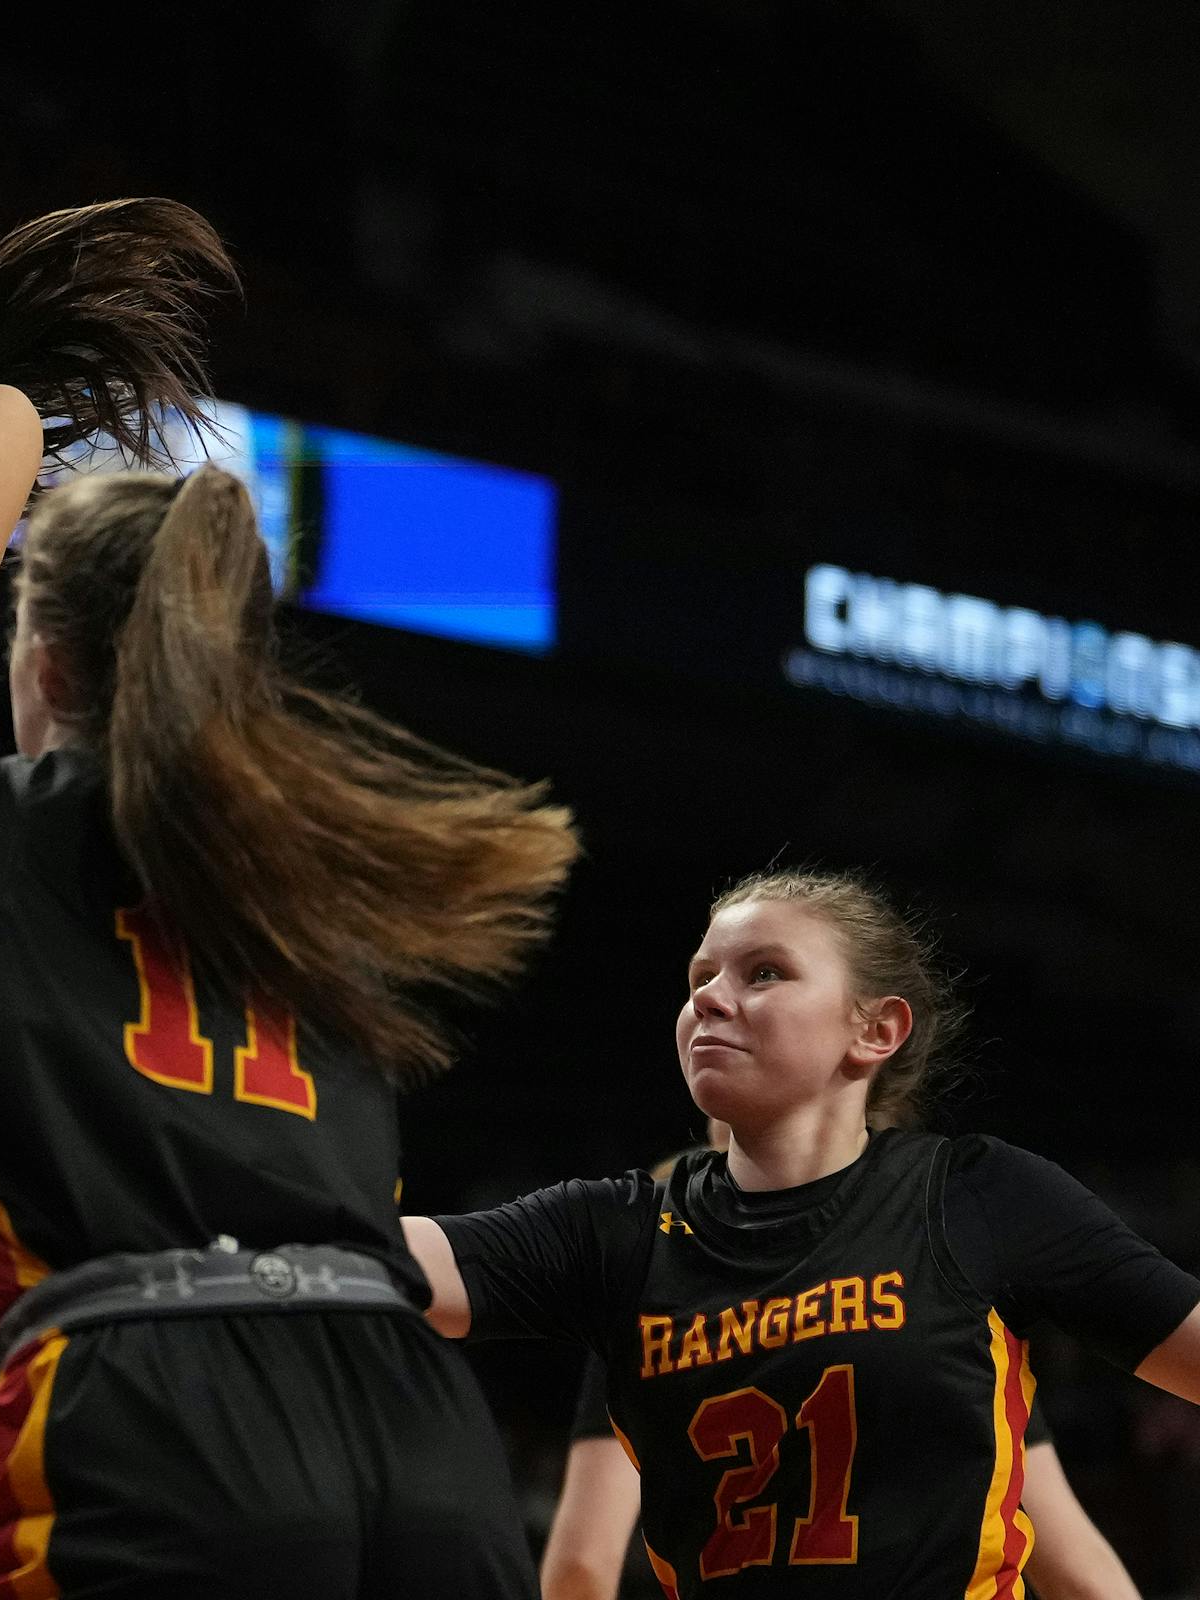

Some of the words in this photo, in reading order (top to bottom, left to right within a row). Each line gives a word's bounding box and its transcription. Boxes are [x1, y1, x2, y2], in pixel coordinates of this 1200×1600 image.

[115, 907, 317, 1122] 11
[639, 1270, 907, 1380] RANGERS
[686, 1363, 860, 1582] 21
